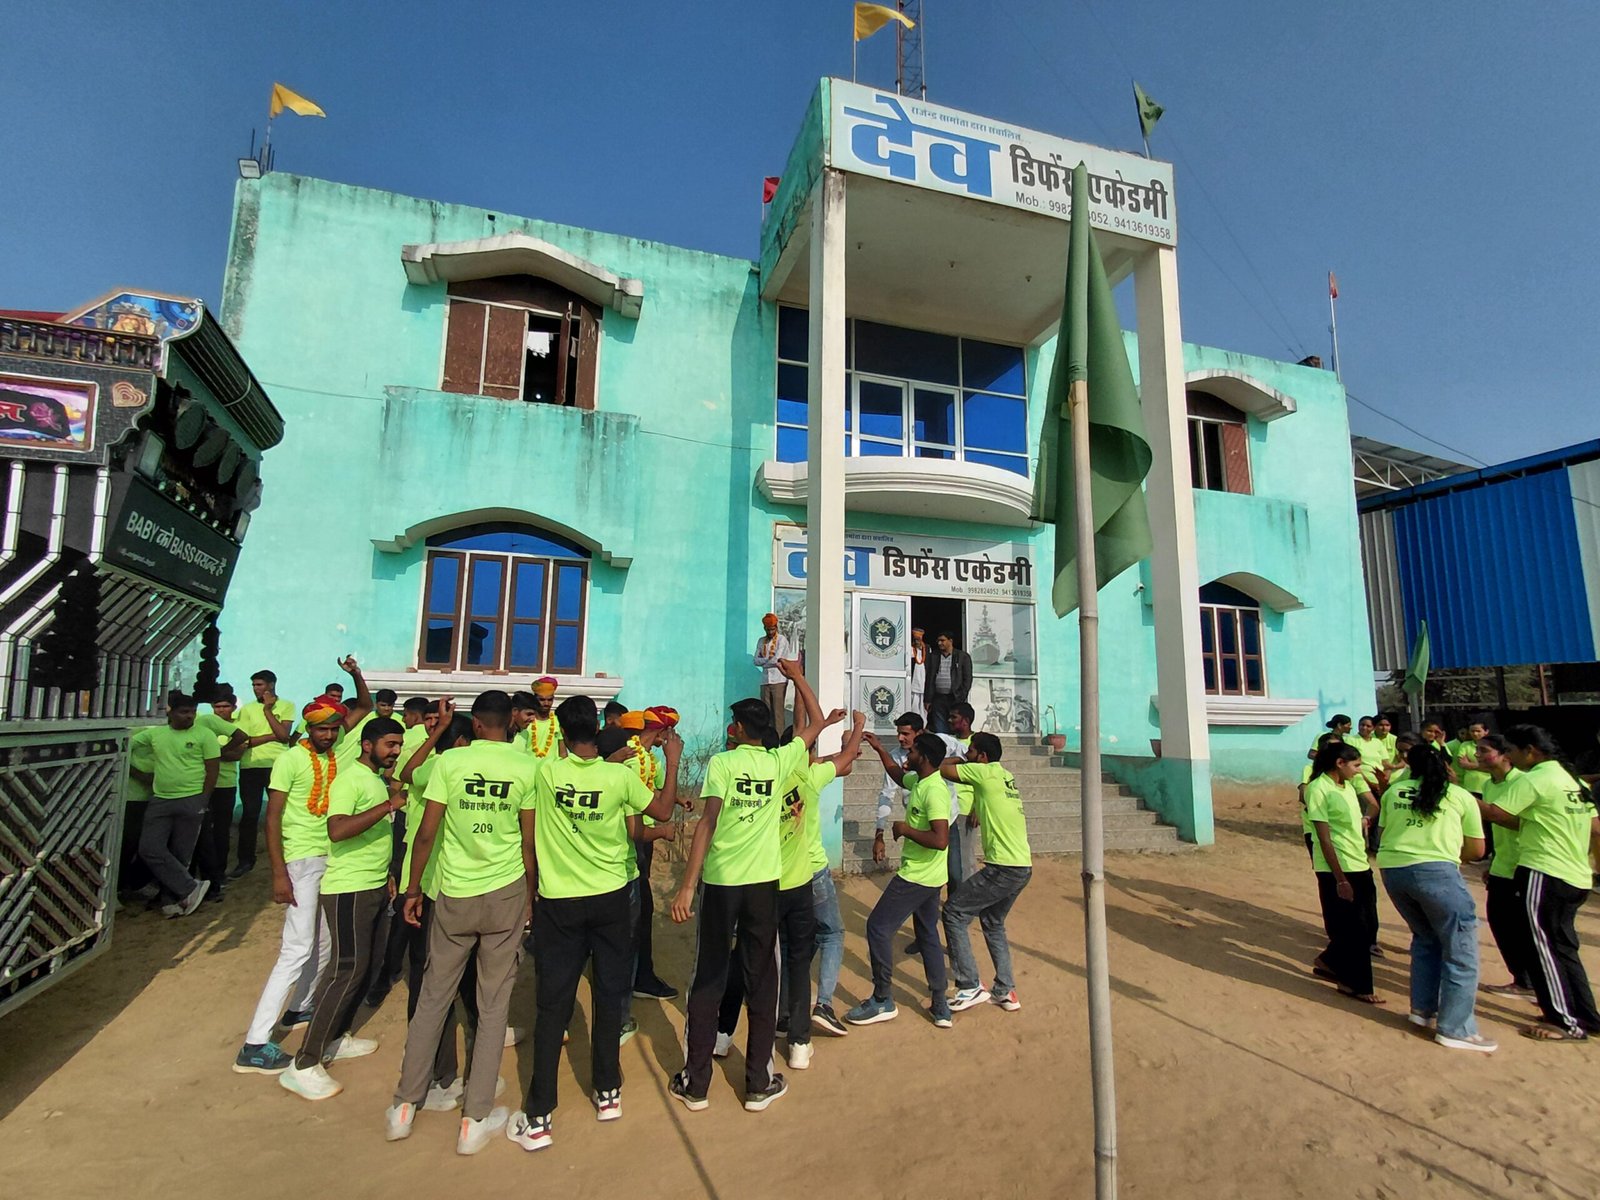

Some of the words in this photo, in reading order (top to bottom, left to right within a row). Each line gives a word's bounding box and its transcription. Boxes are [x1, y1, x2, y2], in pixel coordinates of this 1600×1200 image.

[843, 93, 1000, 198] देव
[1114, 216, 1171, 240] 9413619358
[126, 510, 160, 542] BABY
[169, 536, 197, 563] BASS
[882, 545, 950, 580] डिफेंस
[954, 553, 1032, 586] एकेडमी
[875, 632, 891, 646] देव
[875, 700, 890, 714] देव
[463, 773, 514, 799] देव
[555, 783, 603, 809] देव
[734, 772, 774, 797] देव
[472, 822, 493, 834] 209
